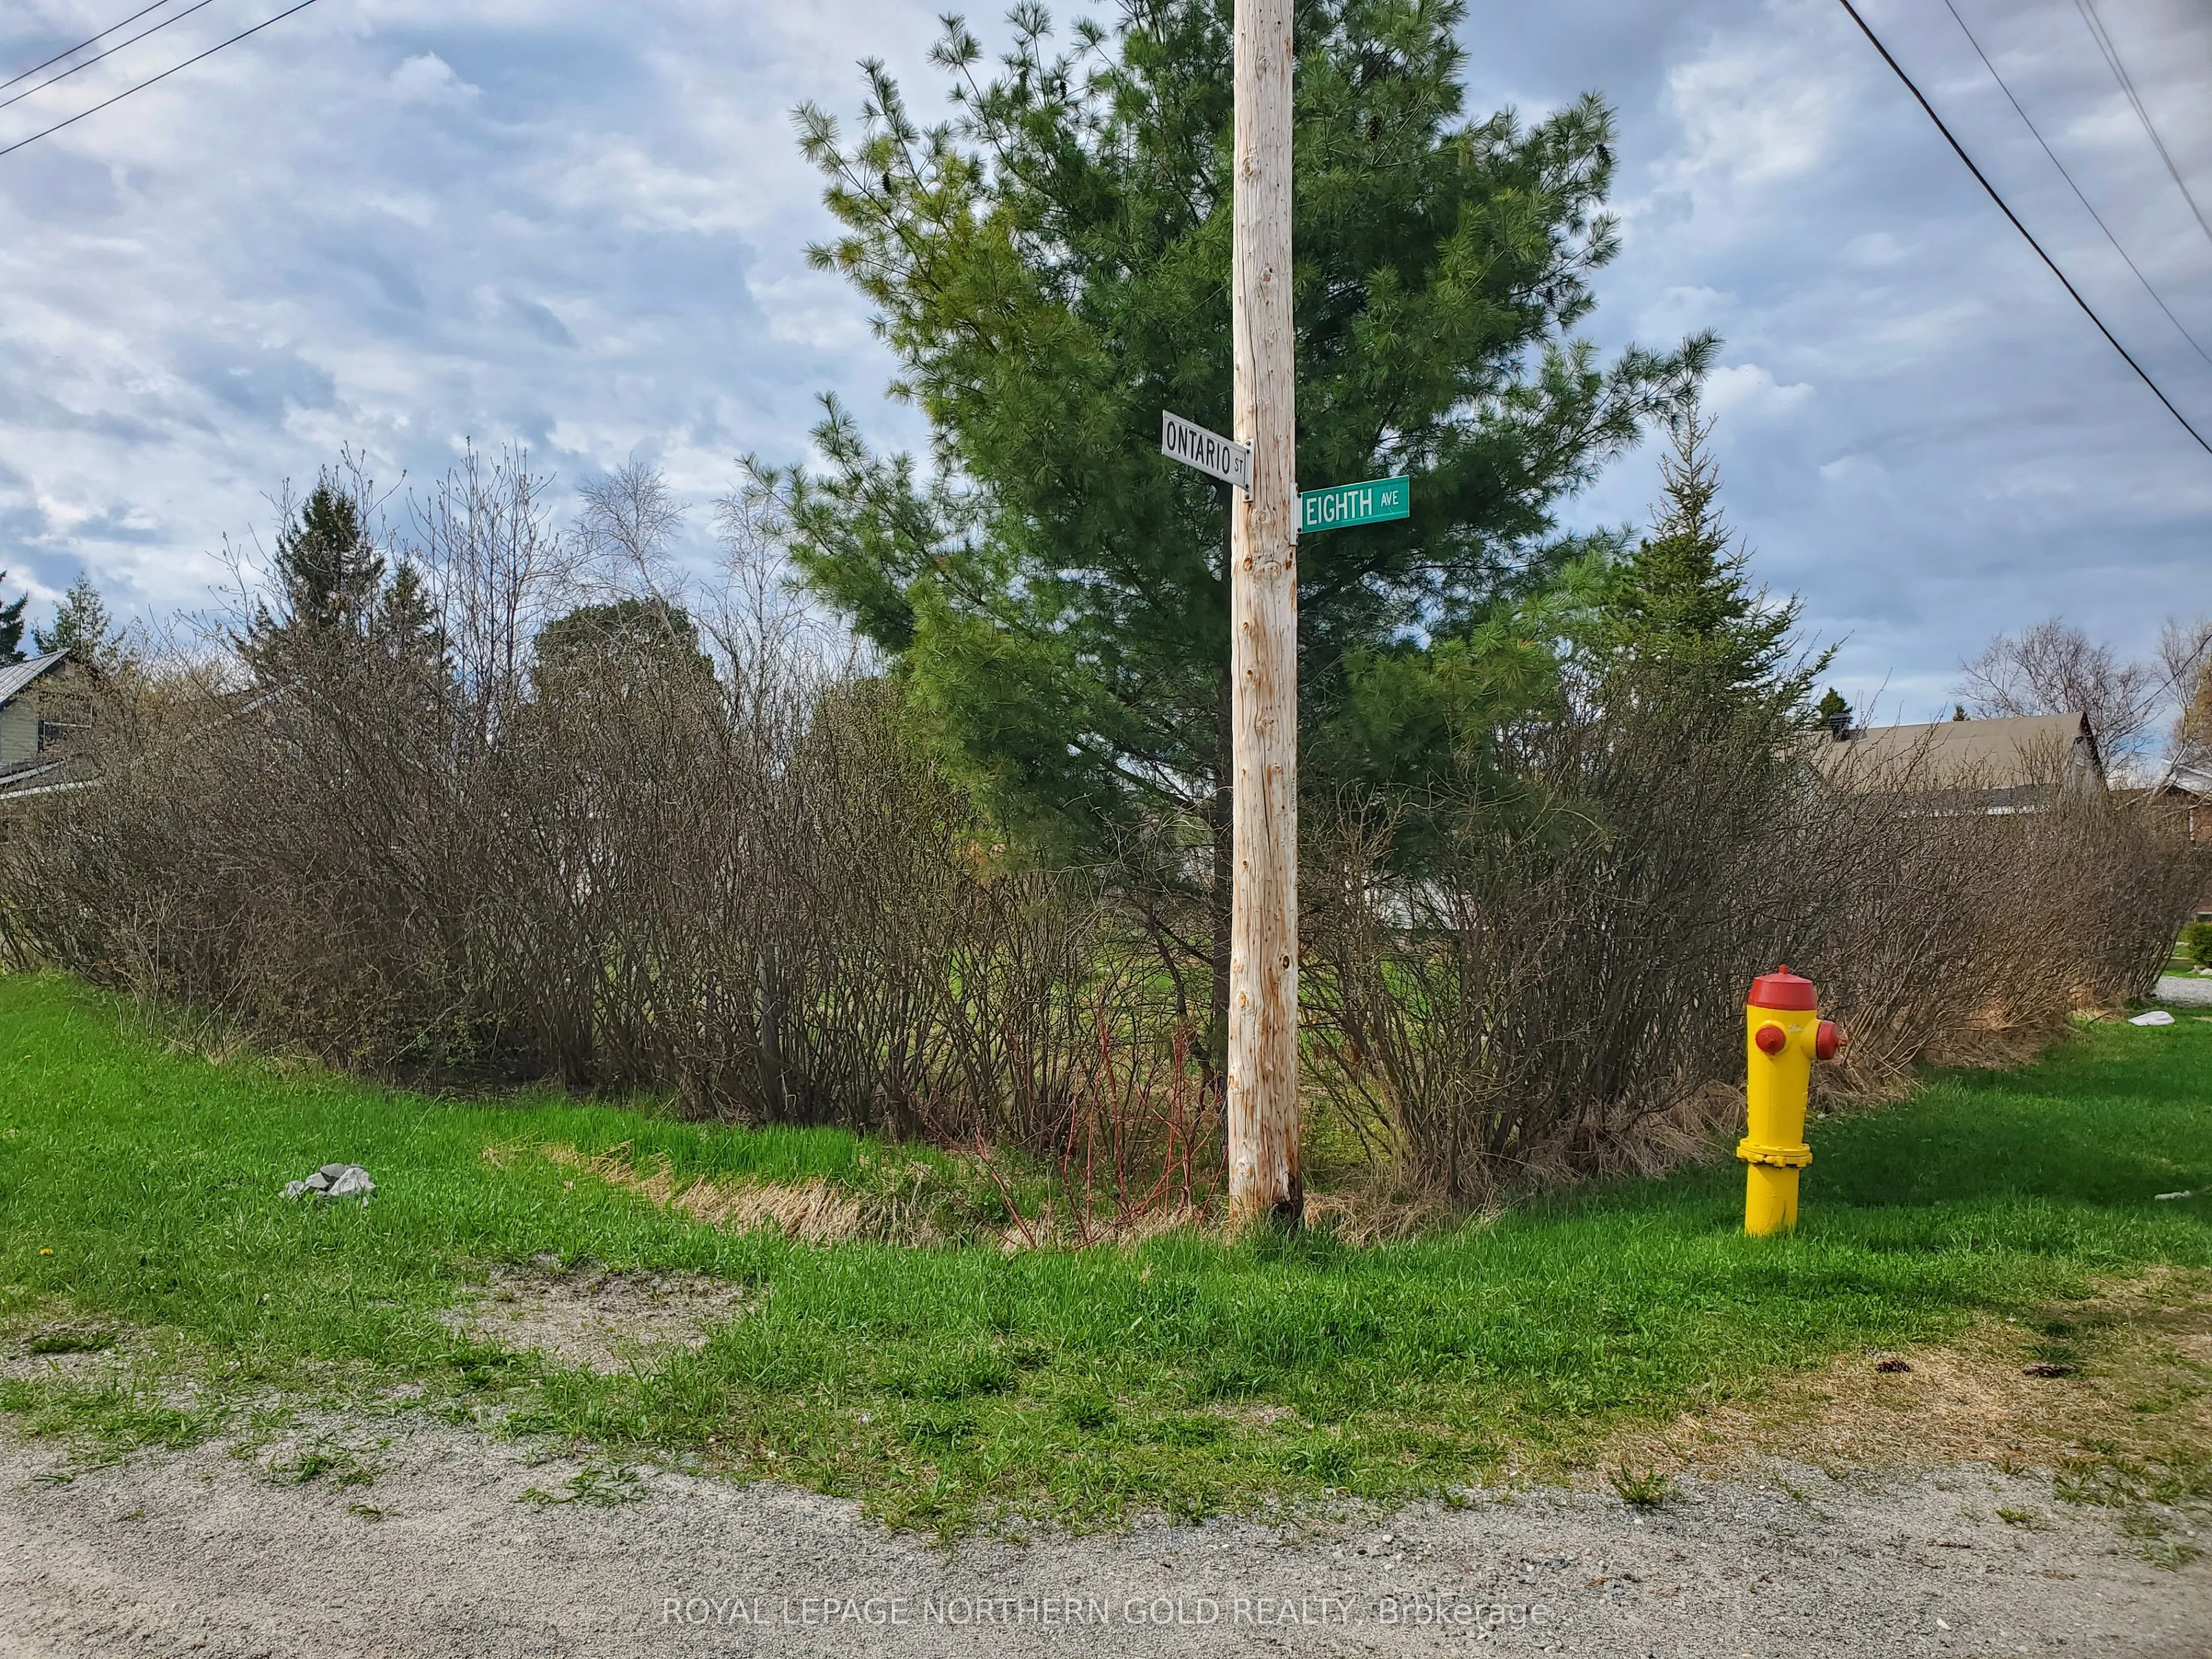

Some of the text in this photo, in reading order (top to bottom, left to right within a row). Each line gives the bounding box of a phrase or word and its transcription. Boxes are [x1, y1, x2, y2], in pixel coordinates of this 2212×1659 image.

[1166, 421, 1243, 474] ONTARIO ST
[1306, 488, 1399, 525] EIGHTH AVE
